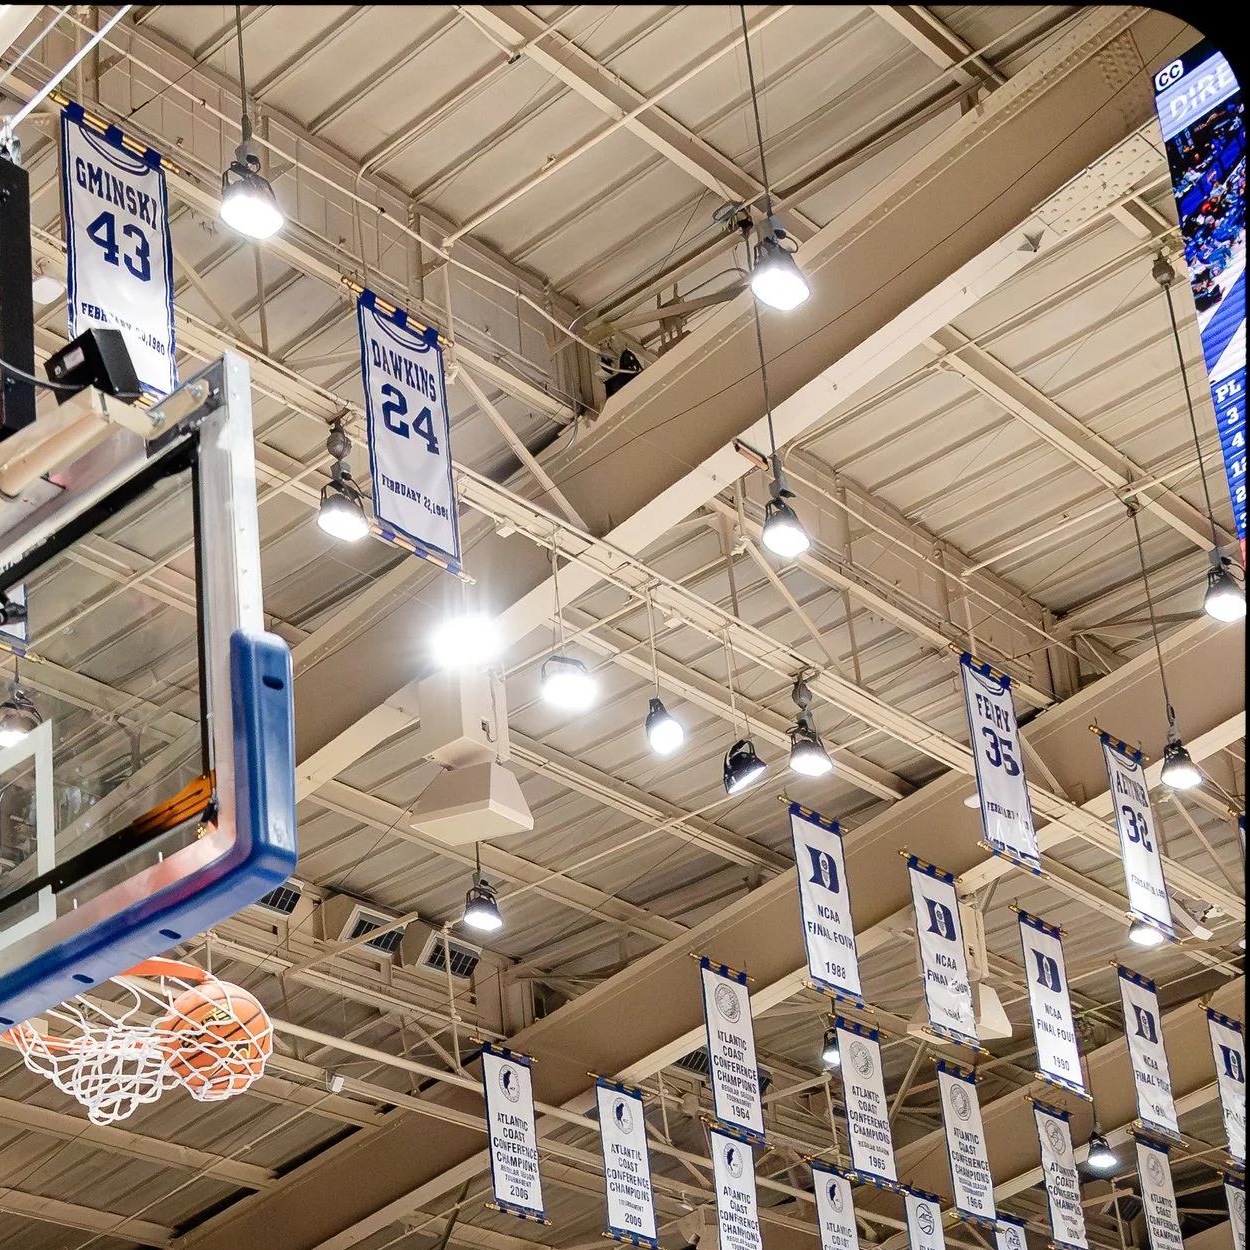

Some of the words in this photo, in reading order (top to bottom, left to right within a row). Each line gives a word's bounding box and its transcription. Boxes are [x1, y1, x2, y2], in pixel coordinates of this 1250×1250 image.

[1158, 64, 1180, 87] CC
[75, 156, 157, 230] GMINSKI
[86, 211, 151, 282] 43
[371, 338, 437, 402] DAWKINS
[1215, 379, 1241, 403] PL
[381, 383, 440, 455] 24
[381, 473, 421, 505] FEBRUARY
[982, 726, 1020, 777] 35
[1122, 805, 1153, 853] 32
[817, 905, 840, 924] NCAA
[808, 922, 832, 940] FINAL
[834, 932, 854, 949] FOUR
[825, 961, 846, 979] 1988
[936, 953, 957, 970] NCAA
[1045, 1003, 1062, 1021] NCAA
[1037, 1020, 1056, 1036] FINAL
[718, 1030, 747, 1051] ATLANTIC
[722, 1046, 744, 1062] COAST
[1143, 1054, 1158, 1070] NCAA
[714, 1055, 756, 1081] CONFERENCE
[1053, 1056, 1070, 1071] 1990
[717, 1070, 757, 1094] CHAMPIONS
[1136, 1071, 1156, 1085] FINAL
[852, 1086, 880, 1104] ATLANTIC
[732, 1105, 750, 1120] 1964
[858, 1100, 877, 1115] COAST
[498, 1113, 528, 1131] ATLANTIC
[503, 1127, 525, 1143] COAST
[954, 1127, 979, 1145] ATLANTIC
[494, 1137, 537, 1160] CONFERENCE
[611, 1144, 642, 1161] ATLANTIC
[959, 1141, 976, 1155] COAST
[497, 1152, 537, 1173] CHAMPIONS
[619, 1157, 638, 1173] COAST
[952, 1151, 988, 1171] CONFERENCE
[607, 1168, 650, 1189] CONFERENCE
[955, 1164, 989, 1183] CHAMPIONS
[1056, 1176, 1074, 1189] COAST
[510, 1185, 528, 1200] 2006
[610, 1181, 650, 1202] CHAMPIONS
[724, 1186, 751, 1204] ATLANTIC
[967, 1196, 982, 1209] 1966
[624, 1213, 642, 1227] 2009
[720, 1210, 759, 1231] CONFERENCE
[723, 1223, 759, 1243] CHAMPIONS
[827, 1222, 852, 1237] ATLANTIC
[832, 1235, 849, 1247] COAST
